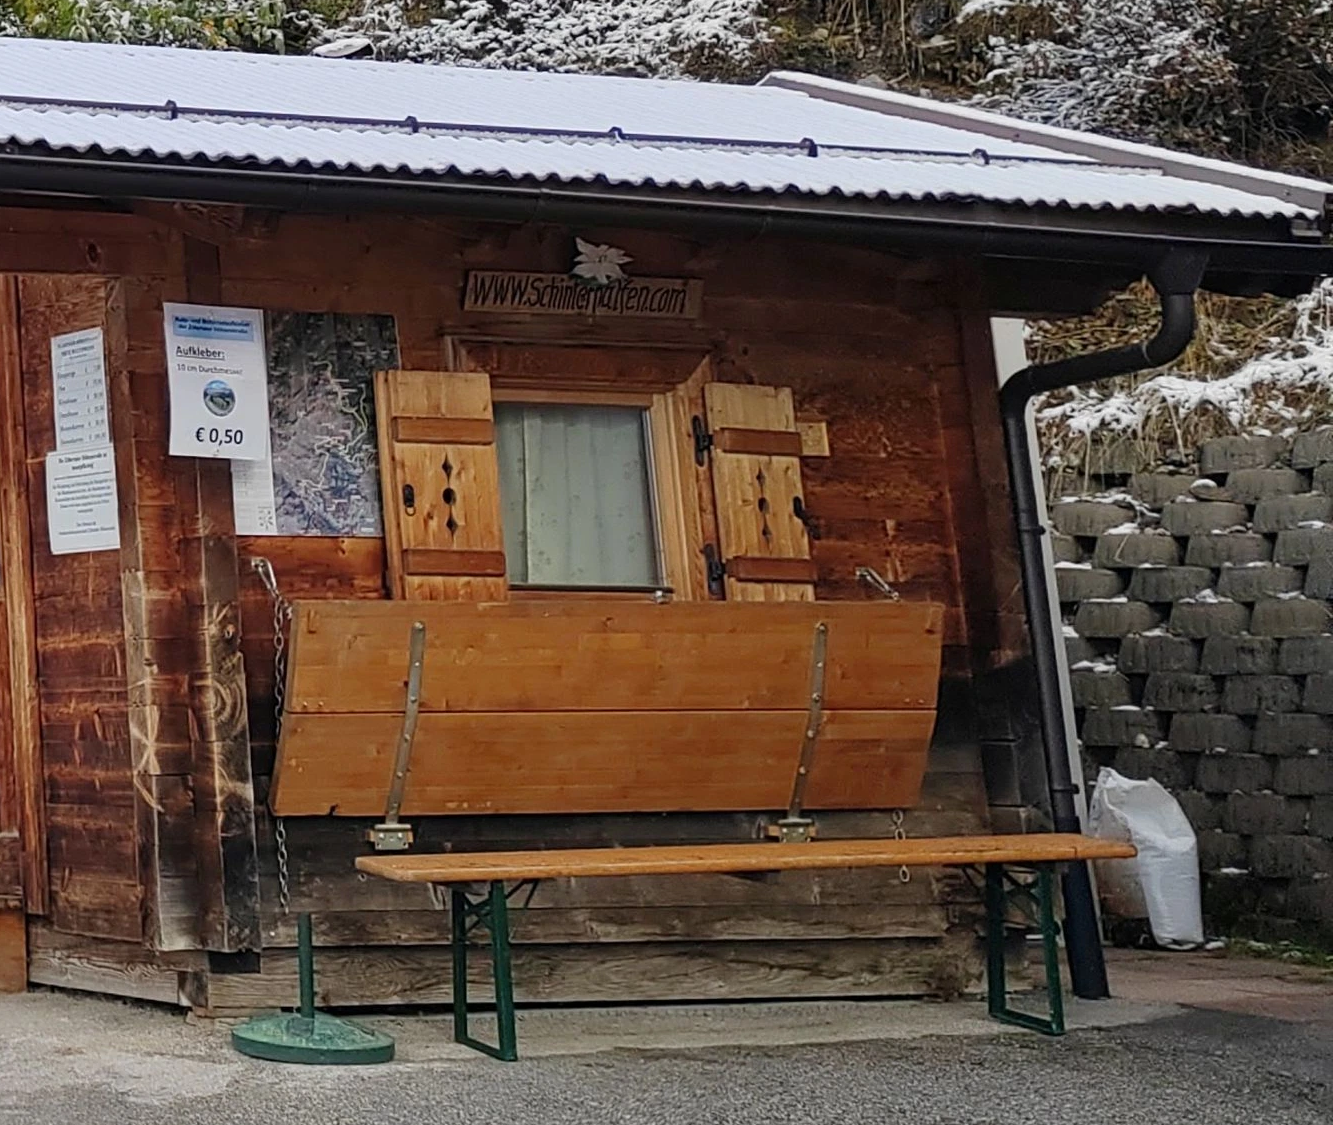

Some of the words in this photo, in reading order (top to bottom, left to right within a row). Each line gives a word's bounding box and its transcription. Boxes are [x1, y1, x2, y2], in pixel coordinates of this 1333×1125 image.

[176, 345, 226, 360] Aufkleber:
[195, 427, 205, 442] €
[209, 427, 244, 448] 0,50
